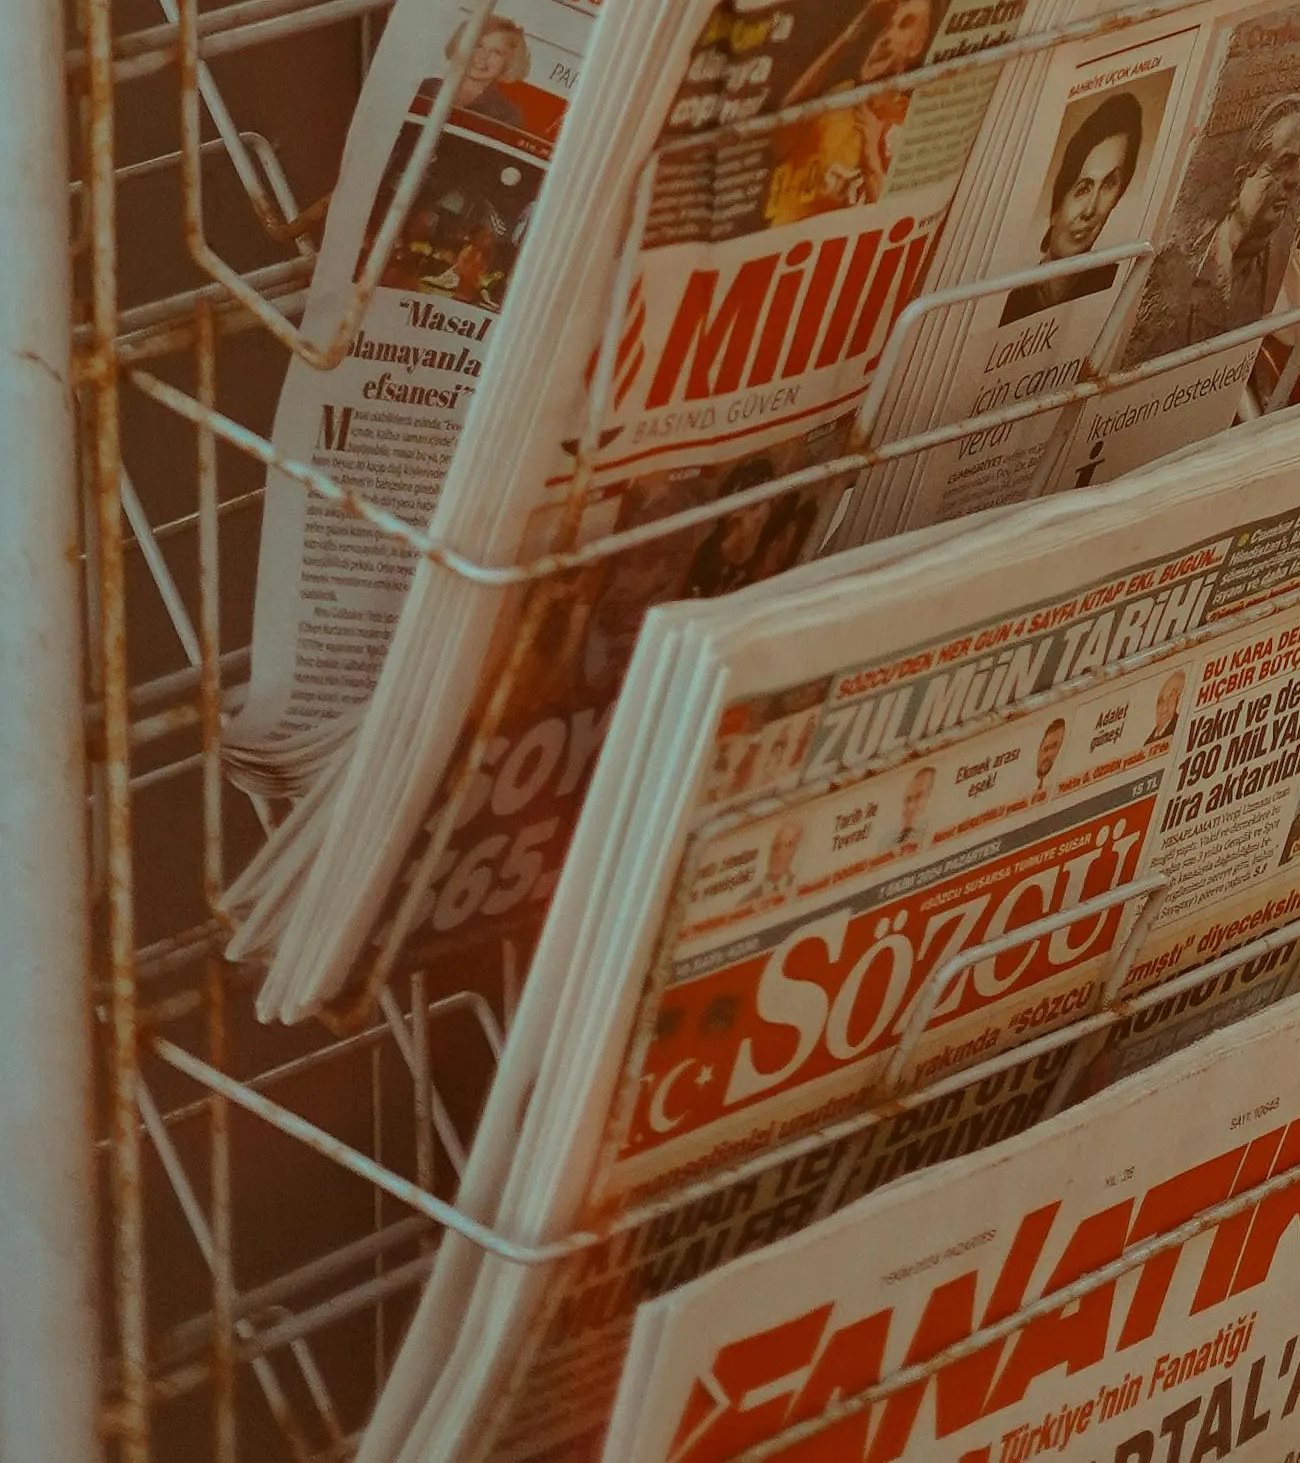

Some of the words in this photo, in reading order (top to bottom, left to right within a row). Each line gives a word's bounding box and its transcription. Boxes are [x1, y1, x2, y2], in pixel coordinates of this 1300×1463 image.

[982, 317, 1061, 375] Laiklik
[728, 384, 801, 424] GÜVEN
[1086, 396, 1160, 444] İktidarın
[806, 632, 1052, 777] ZULMÜN
[1055, 573, 1217, 682] TARİHİ
[1203, 658, 1226, 683] BU
[1229, 637, 1273, 674] KARA
[1196, 666, 1256, 709] HİÇBİR
[1186, 699, 1243, 754] Vakıf
[1245, 691, 1272, 720] ve
[1177, 746, 1223, 794] 190
[1160, 789, 1204, 833] lira
[1057, 833, 1092, 861] SUSAR
[724, 817, 1141, 1107] SÖZCÜ
[1000, 1372, 1143, 1463] Türkiye'nin
[1147, 1310, 1259, 1401] Fanatiği
